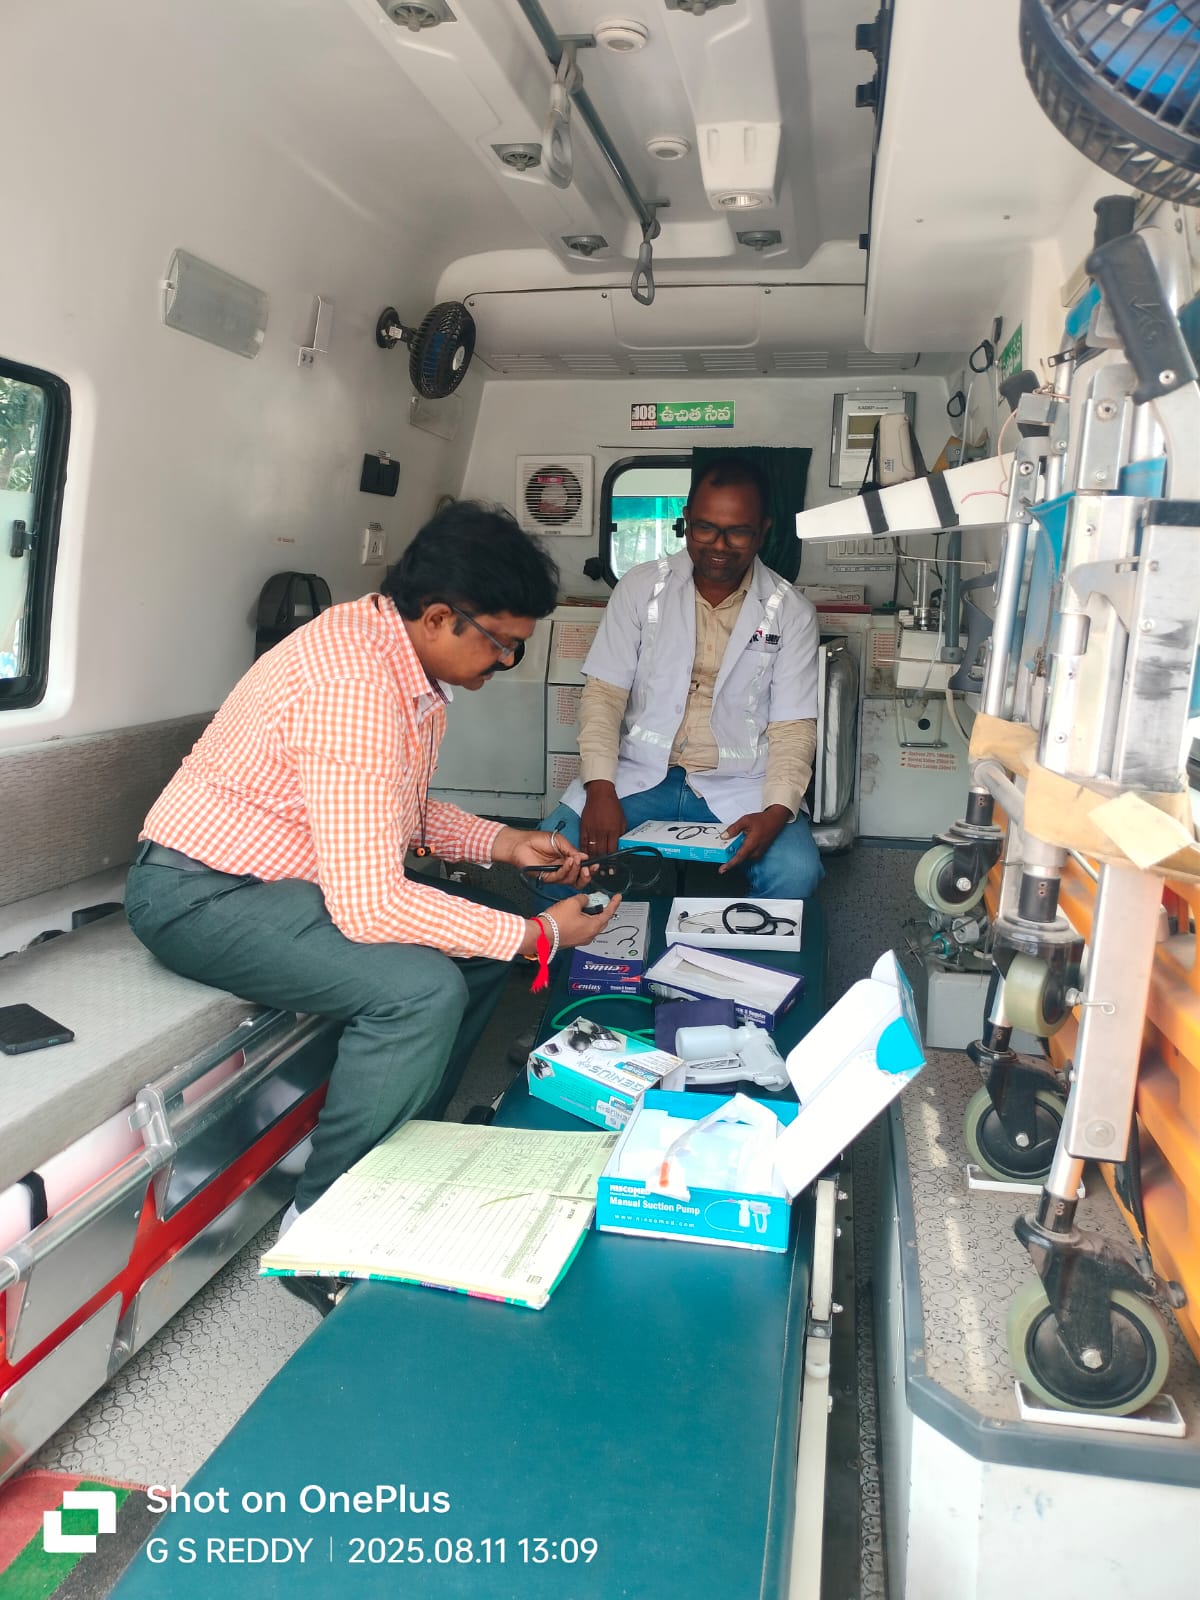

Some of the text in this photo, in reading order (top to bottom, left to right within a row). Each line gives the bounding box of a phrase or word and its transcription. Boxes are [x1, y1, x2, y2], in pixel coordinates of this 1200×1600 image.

[632, 405, 657, 420] 108
[660, 404, 731, 422] ఉచిత సేవ
[571, 982, 601, 992] Genius
[609, 1196, 701, 1217] Manual Suction Pump
